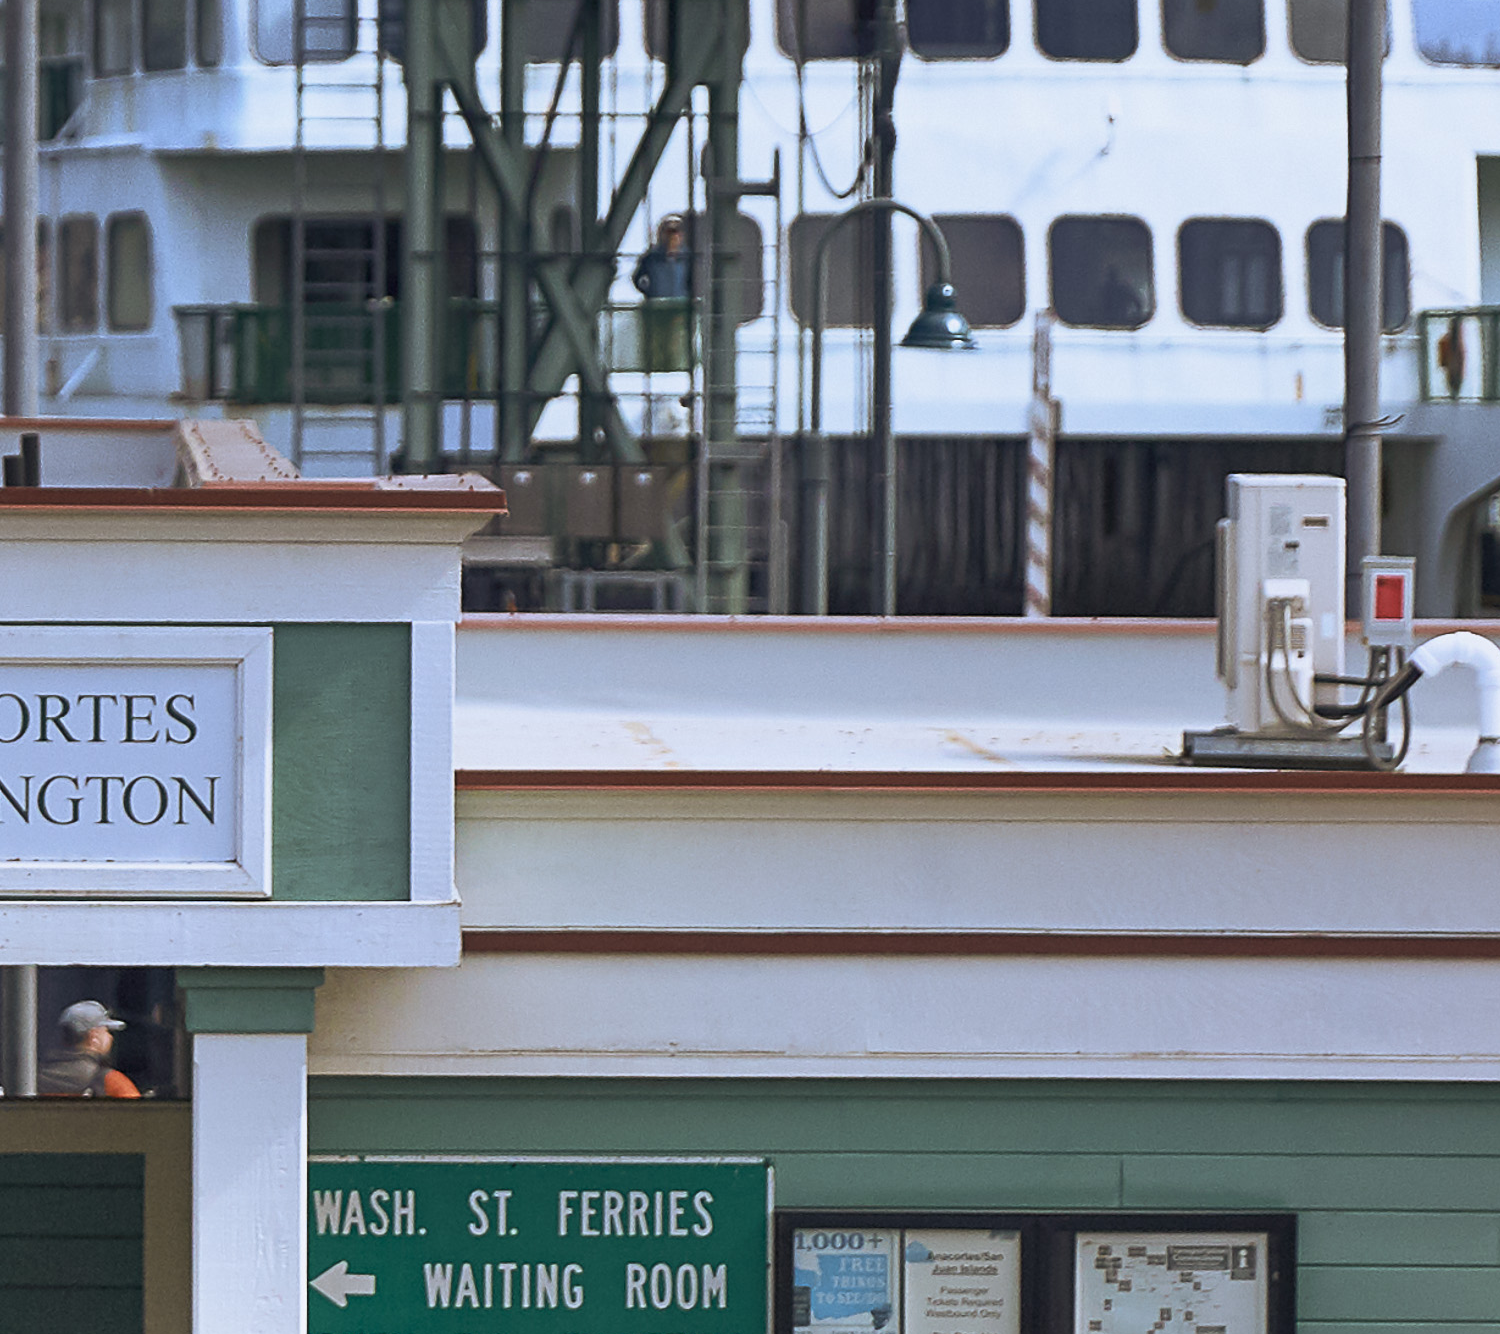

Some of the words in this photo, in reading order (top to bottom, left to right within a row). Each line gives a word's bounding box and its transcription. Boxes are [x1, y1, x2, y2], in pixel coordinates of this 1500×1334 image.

[313, 1189, 427, 1236] WASH.
[467, 1189, 519, 1236] ST.
[557, 1190, 715, 1236] FERRIES
[423, 1262, 584, 1309] WAITING
[625, 1263, 728, 1309] ROOM
